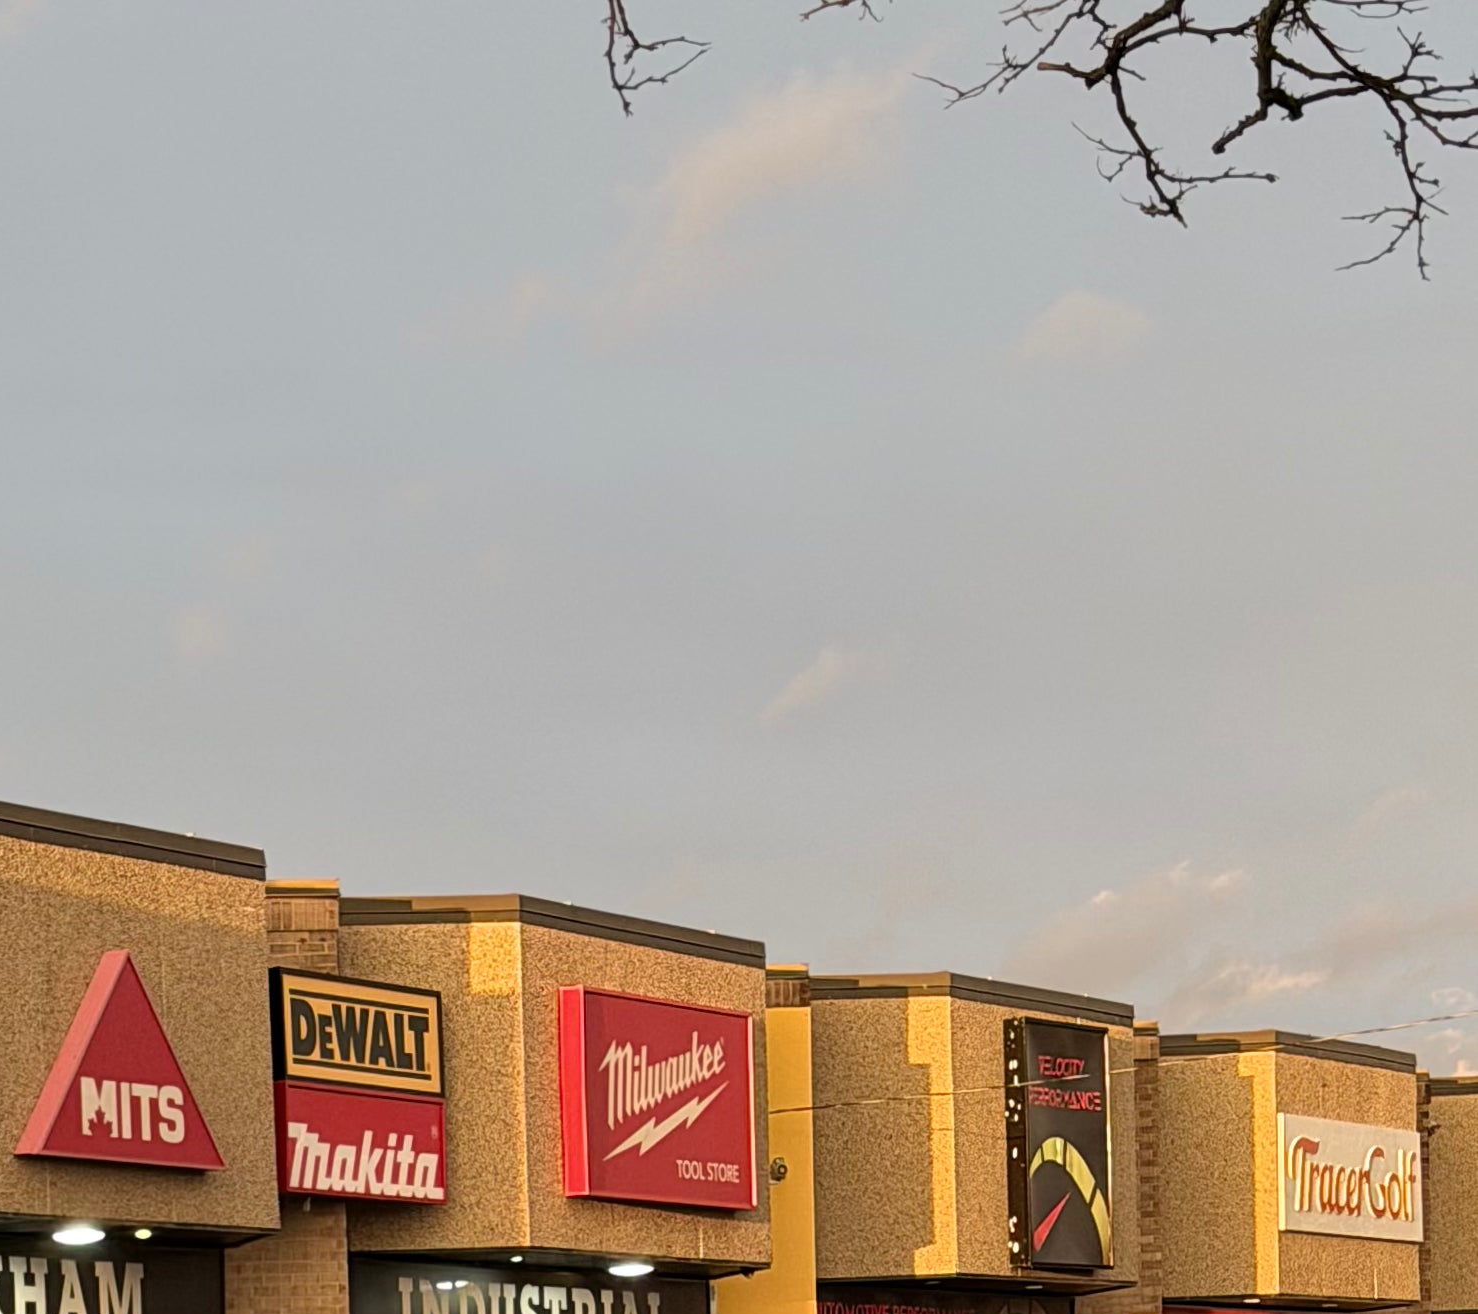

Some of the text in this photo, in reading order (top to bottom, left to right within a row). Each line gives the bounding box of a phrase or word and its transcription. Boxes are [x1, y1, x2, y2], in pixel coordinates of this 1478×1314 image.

[1038, 1055, 1085, 1077] VELOCITY
[598, 1030, 726, 1131] Milwaukee
[80, 1076, 185, 1144] MITS
[1028, 1086, 1102, 1112] PERFORMANCE
[676, 1159, 740, 1183] TOOL STORE
